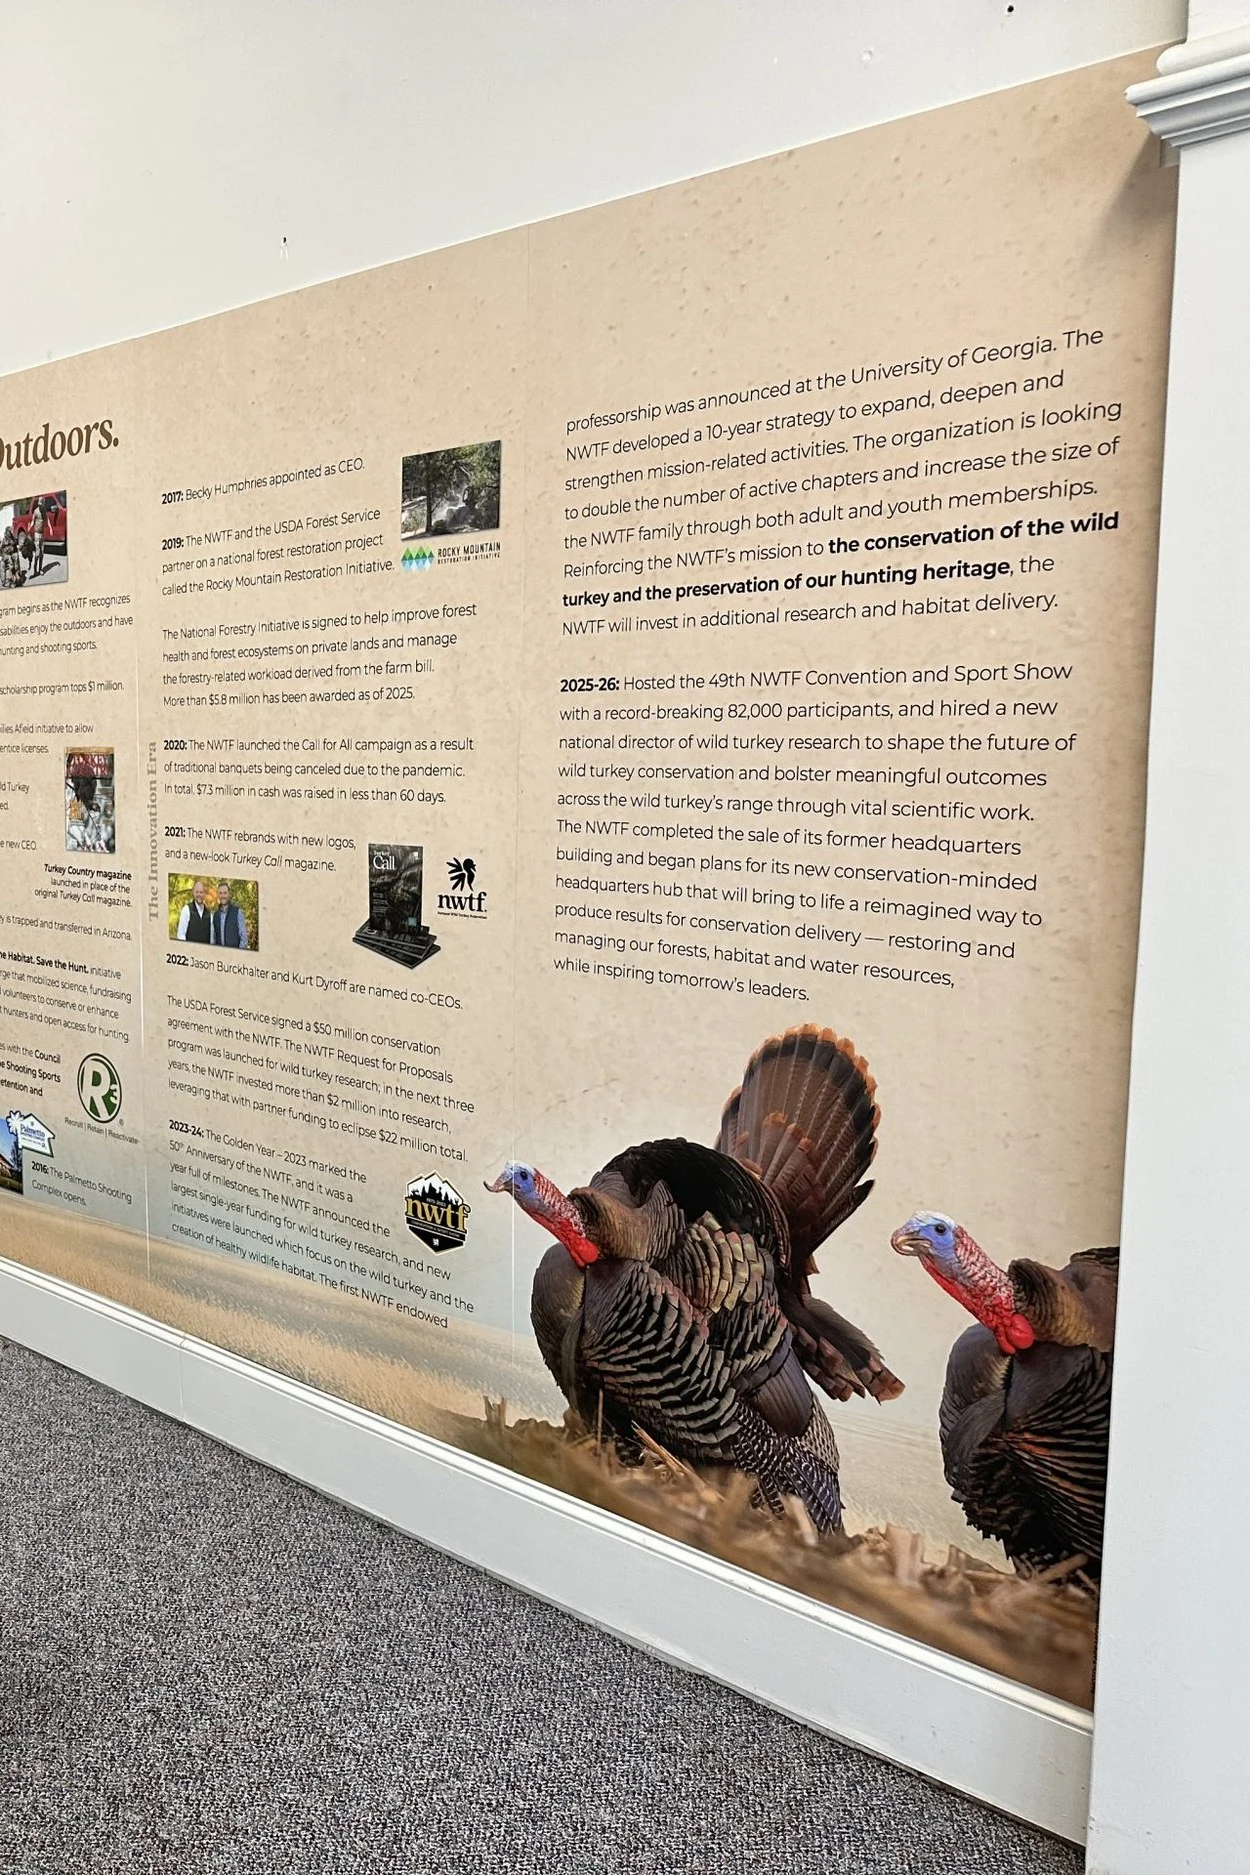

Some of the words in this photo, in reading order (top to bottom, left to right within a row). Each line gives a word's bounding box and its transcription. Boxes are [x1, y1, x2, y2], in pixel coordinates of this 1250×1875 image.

[566, 403, 661, 435] professorship
[664, 399, 695, 415] was
[698, 378, 791, 409] announced
[795, 377, 812, 393] at
[816, 372, 846, 390] the
[851, 355, 943, 384] University
[947, 348, 968, 368] of
[971, 335, 1057, 363] Georgia.
[1062, 328, 1103, 348] The
[161, 490, 184, 504] 2017:
[185, 485, 212, 500] Becky
[214, 477, 267, 495] Humphries
[268, 463, 321, 487] appointed
[323, 464, 336, 476] as
[338, 457, 365, 473] CEO.
[438, 546, 460, 558] ROCKY
[464, 542, 500, 554] MOUNTAIN
[564, 558, 643, 577] Reinforcing
[646, 554, 672, 570] the
[676, 547, 736, 567] NWTF's
[738, 542, 803, 562] mission
[807, 540, 824, 556] to
[828, 536, 860, 554] the
[864, 524, 994, 552] conservation
[999, 519, 1023, 538] of
[1026, 518, 1064, 536] the
[1070, 510, 1119, 532] wild
[562, 590, 610, 607] turkey
[612, 586, 642, 602] and
[644, 584, 672, 600] the
[675, 576, 779, 601] preservation
[783, 572, 802, 590] of
[805, 574, 837, 588] our
[841, 565, 917, 586] hunting
[922, 559, 1014, 580] heritage,
[1019, 555, 1054, 572] the
[38, 684, 69, 695] program
[69, 683, 87, 694] tops
[87, 680, 96, 693] $1
[560, 676, 620, 692] 2025-26:
[623, 674, 675, 690] Hosted
[679, 673, 705, 688] the
[708, 672, 745, 687] 49th
[750, 670, 802, 686] NWTF
[805, 667, 906, 685] Convention
[912, 664, 948, 682] and
[953, 665, 1008, 685] Sport
[1013, 662, 1073, 680] Show
[147, 742, 156, 775] Era
[148, 780, 158, 881] Innovation
[44, 863, 66, 876] Turkey
[67, 865, 95, 878] Country
[95, 869, 132, 883] magazine
[373, 856, 396, 870] Call
[149, 886, 158, 922] The
[7, 950, 35, 964] Habitat.
[35, 955, 53, 967] Save
[53, 958, 67, 970] the
[67, 961, 89, 974] Hunt.
[90, 967, 121, 979] initiative
[166, 952, 189, 966] 2022:
[189, 956, 214, 970] Jason
[216, 960, 269, 978] Burckhalter
[270, 970, 290, 982] and
[292, 972, 313, 986] Kurt
[315, 975, 347, 991] Dyroff
[348, 983, 366, 994] are
[368, 986, 408, 1000] named
[410, 992, 463, 1009] co-CEOs.
[553, 956, 590, 973] while
[593, 960, 654, 984] inspiring
[657, 969, 744, 992] tomorrow's
[748, 978, 809, 1000] leaders.
[31, 1160, 49, 1174] 2016:
[49, 1166, 63, 1179] The
[63, 1171, 97, 1190] Palmetto
[97, 1182, 132, 1204] Shooting
[31, 1179, 63, 1198] Complex
